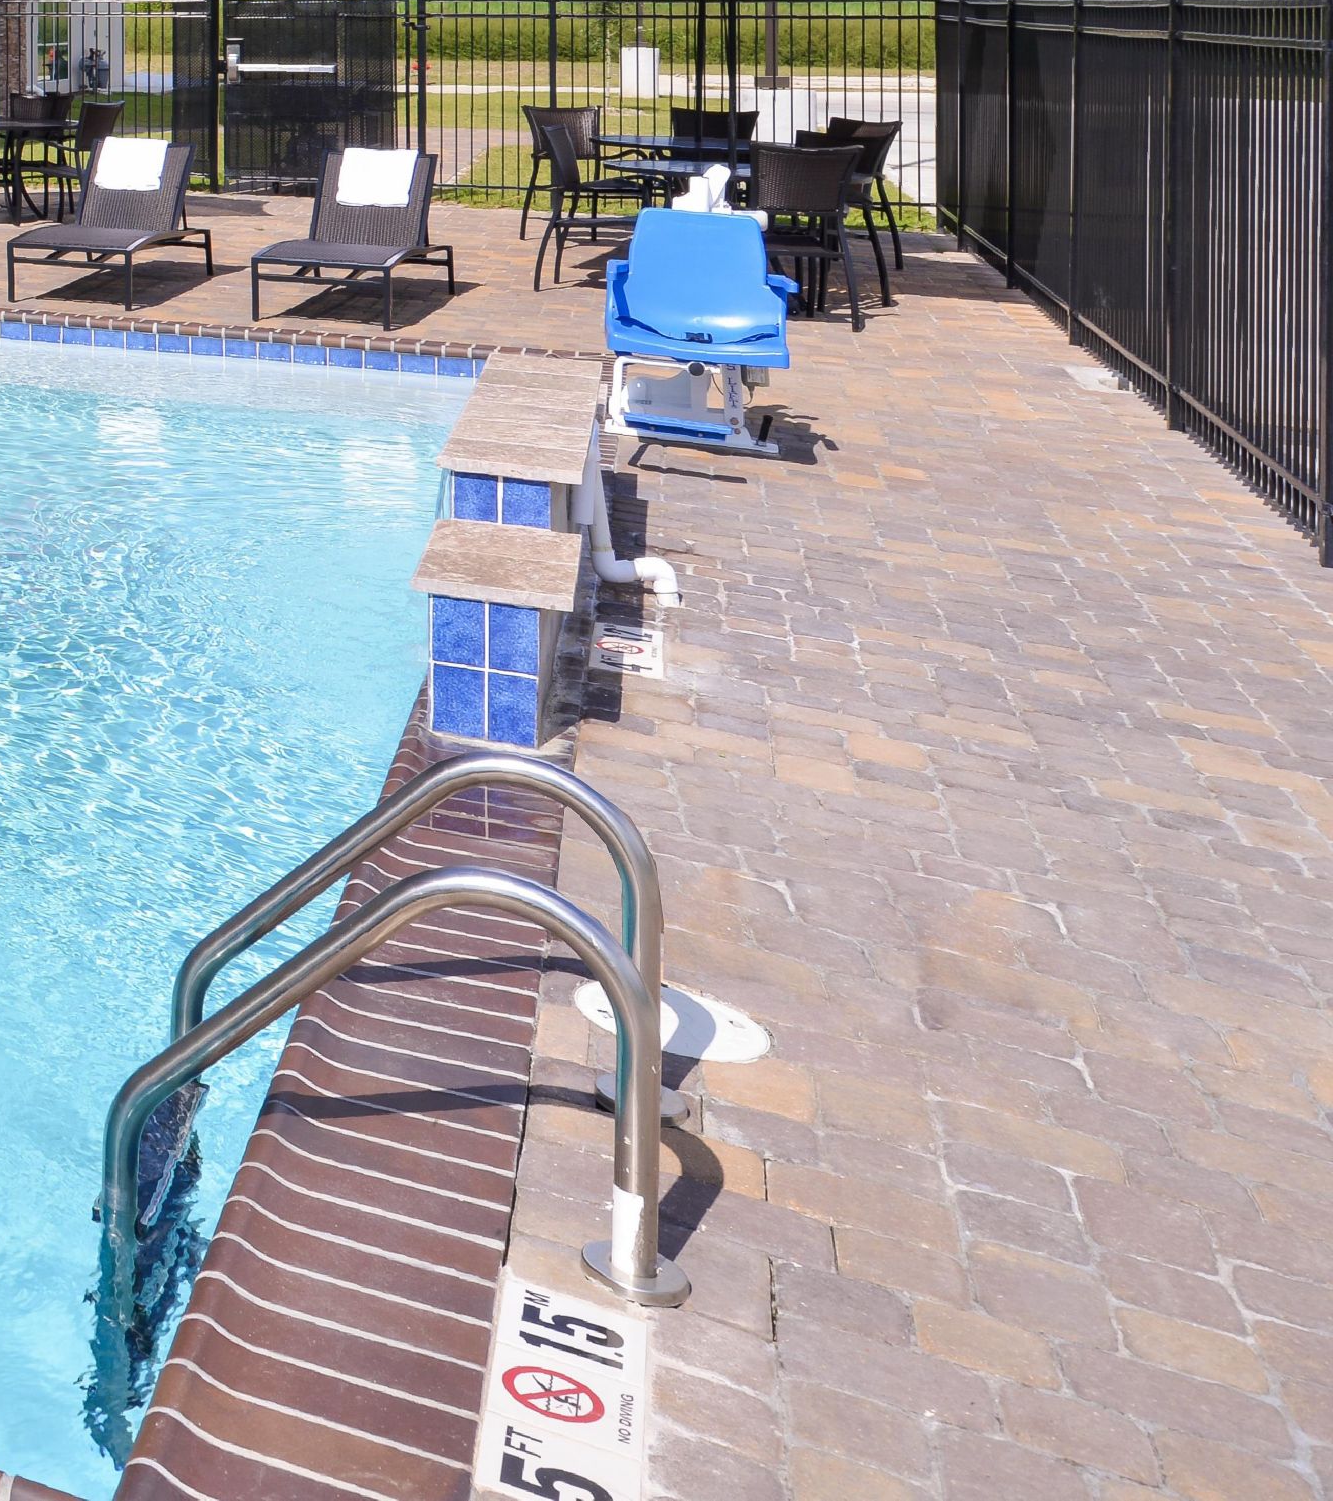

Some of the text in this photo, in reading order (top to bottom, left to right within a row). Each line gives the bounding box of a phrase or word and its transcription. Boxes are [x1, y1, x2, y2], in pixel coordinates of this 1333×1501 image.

[523, 1289, 550, 1307] M
[617, 1393, 634, 1444] NO DIVING
[504, 1425, 543, 1459] FT
